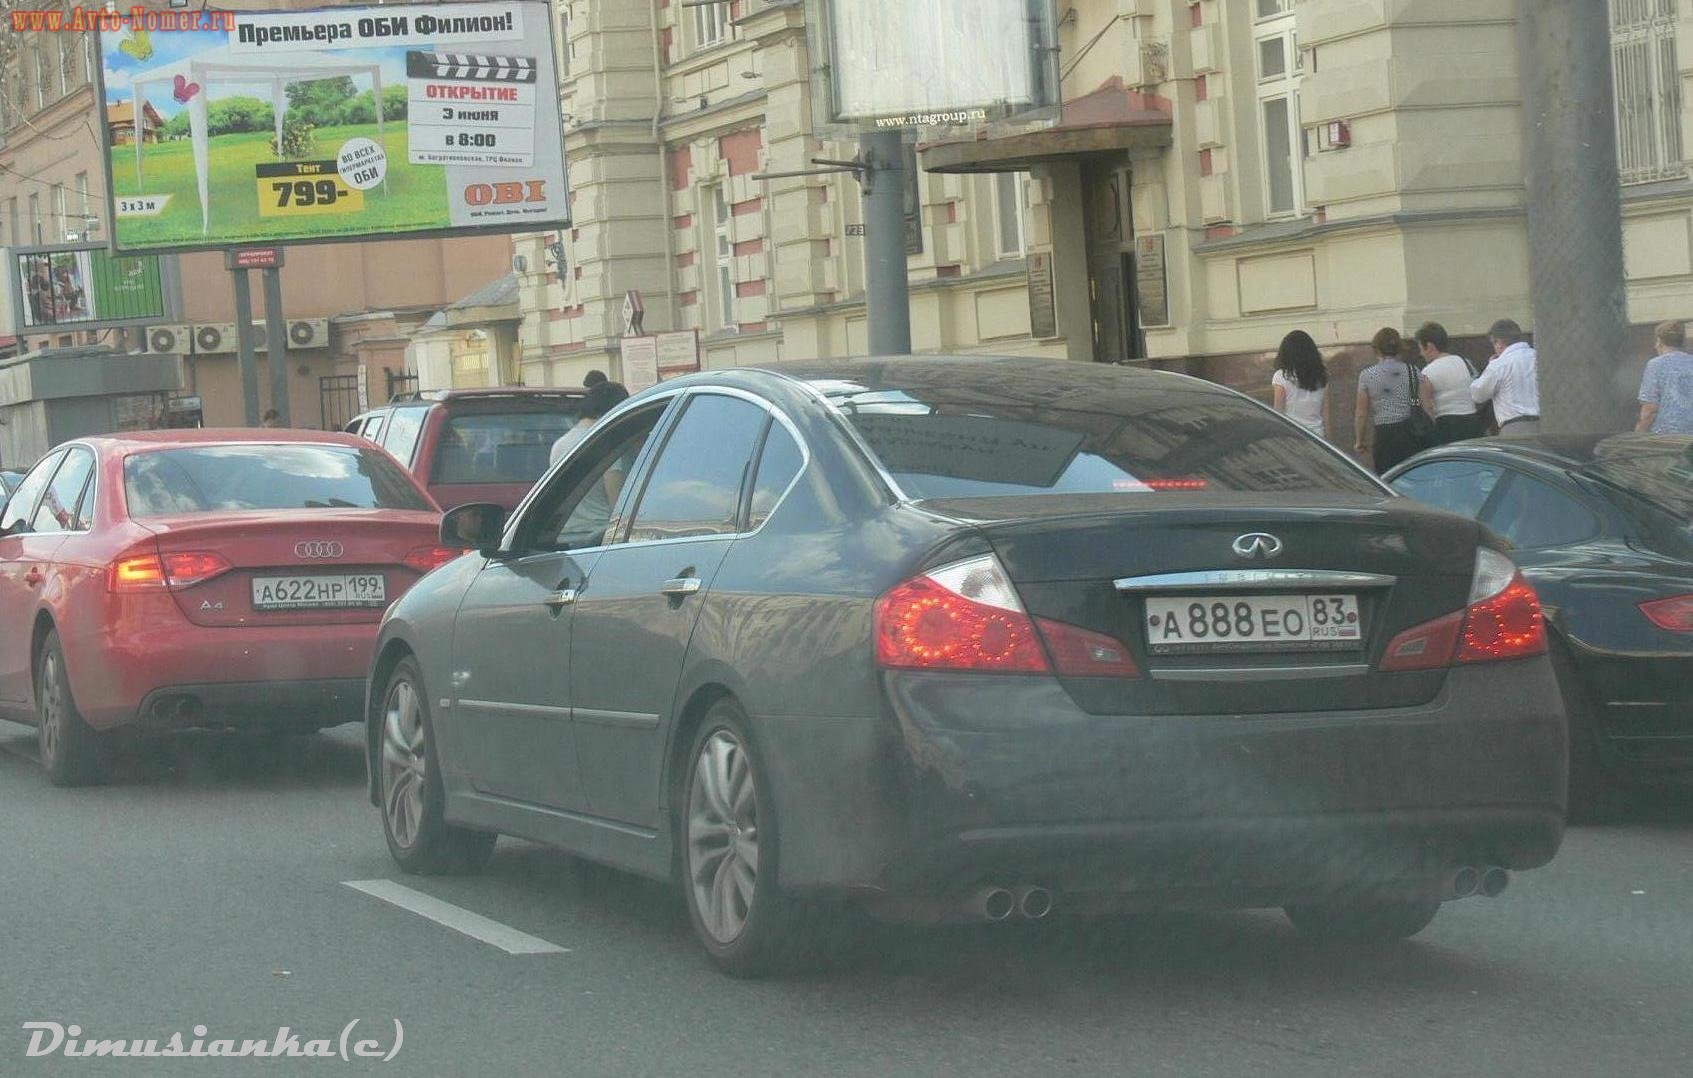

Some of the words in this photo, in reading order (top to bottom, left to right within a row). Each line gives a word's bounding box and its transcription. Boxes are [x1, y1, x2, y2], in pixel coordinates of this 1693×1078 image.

[238, 22, 352, 46] Премьера
[358, 17, 409, 38] ОБИ
[414, 12, 513, 35] Филион!
[426, 84, 518, 101] ОТКРЫТИЕ
[442, 107, 454, 120] 3
[458, 110, 499, 121] июня
[875, 109, 986, 128] www.ntagroup.ru
[445, 135, 455, 146] в
[458, 133, 497, 147] 8:00
[341, 154, 354, 164] ВО
[355, 145, 376, 160] ВСЕХ
[296, 163, 321, 174] Тент
[353, 166, 379, 185] ОБИ
[464, 180, 546, 206] OBI
[121, 201, 127, 212] 3
[137, 200, 144, 211] 3
[348, 576, 379, 594] 199
[199, 600, 224, 610] A4
[1312, 598, 1346, 626] 83
[1312, 626, 1339, 637] RUS
